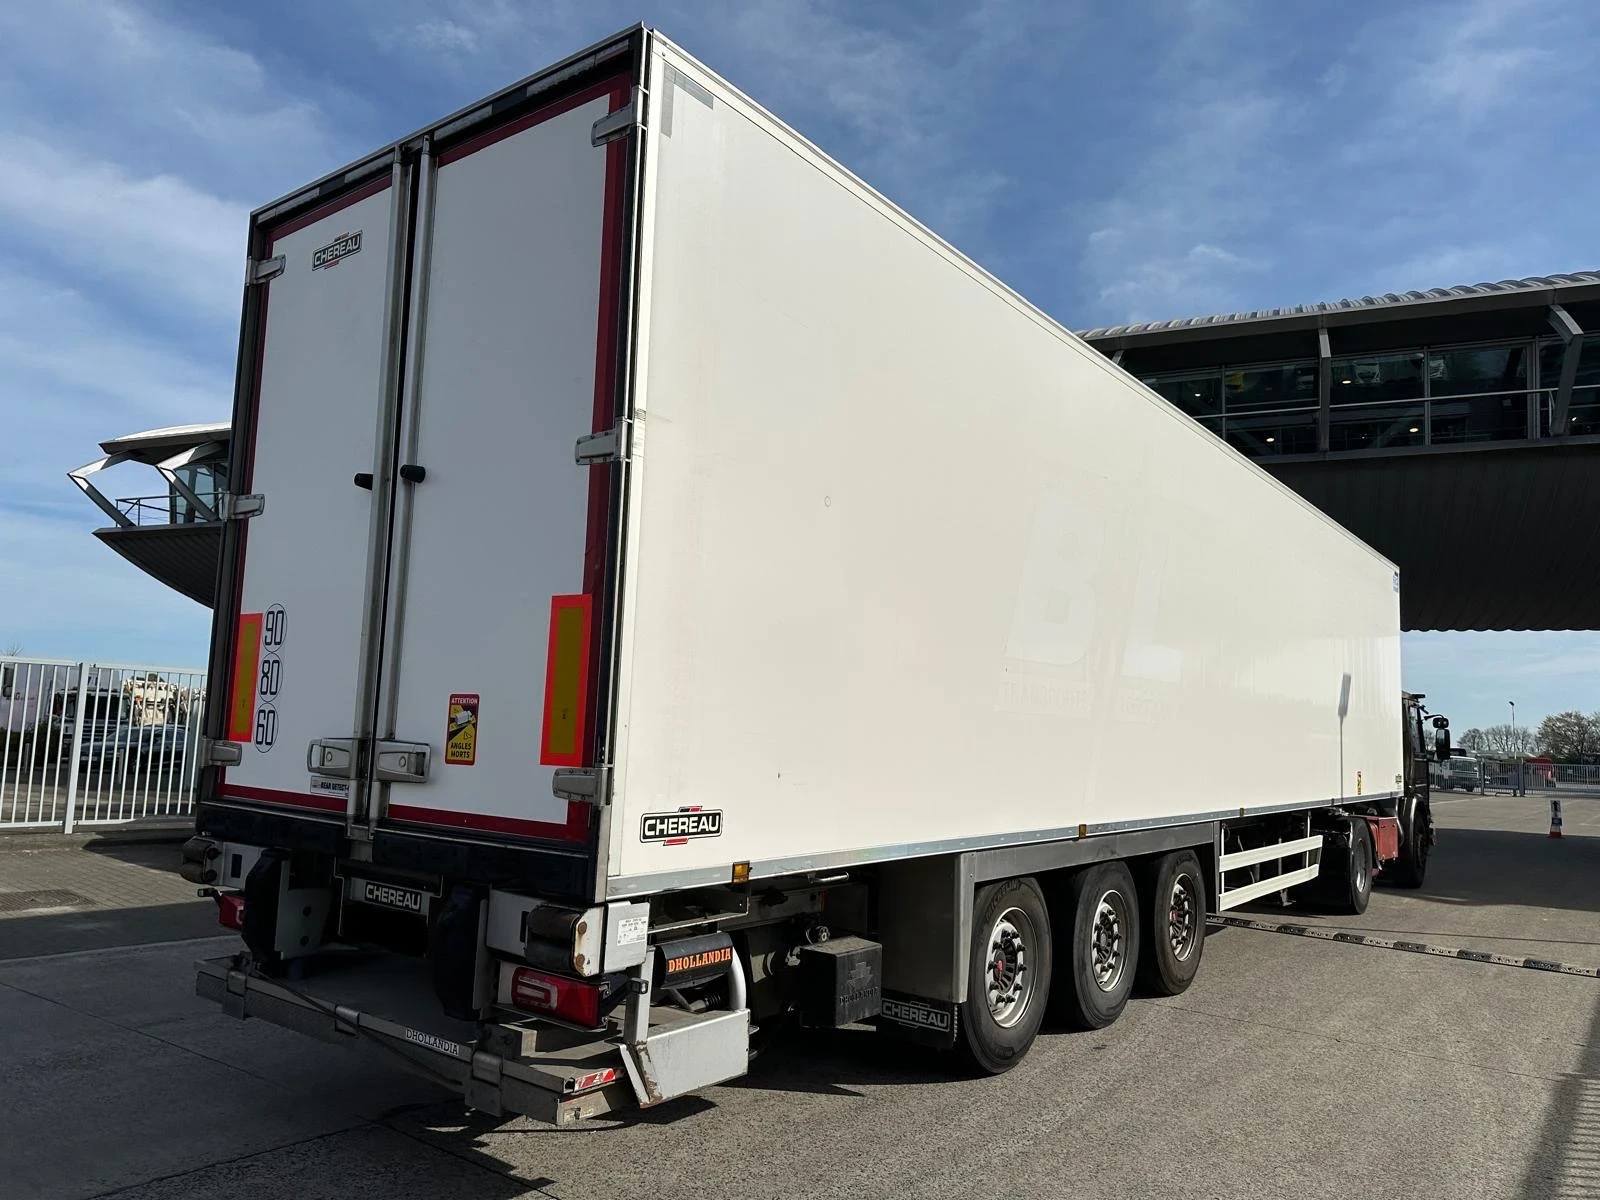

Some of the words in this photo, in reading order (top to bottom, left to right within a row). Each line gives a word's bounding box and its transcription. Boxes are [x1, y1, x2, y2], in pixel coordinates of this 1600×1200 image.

[314, 235, 360, 266] CHEREAU
[264, 610, 285, 646] 90
[260, 660, 280, 695] 80
[255, 710, 275, 745] 60
[450, 742, 472, 750] ANGLES
[450, 751, 470, 759] MORTS
[644, 815, 720, 836] CHEREAU
[366, 884, 421, 910] CHEREAU
[668, 947, 732, 973] DHOLLANDIA
[882, 1002, 948, 1027] CHEREAU
[406, 1029, 458, 1055] DHOLLANDIA
